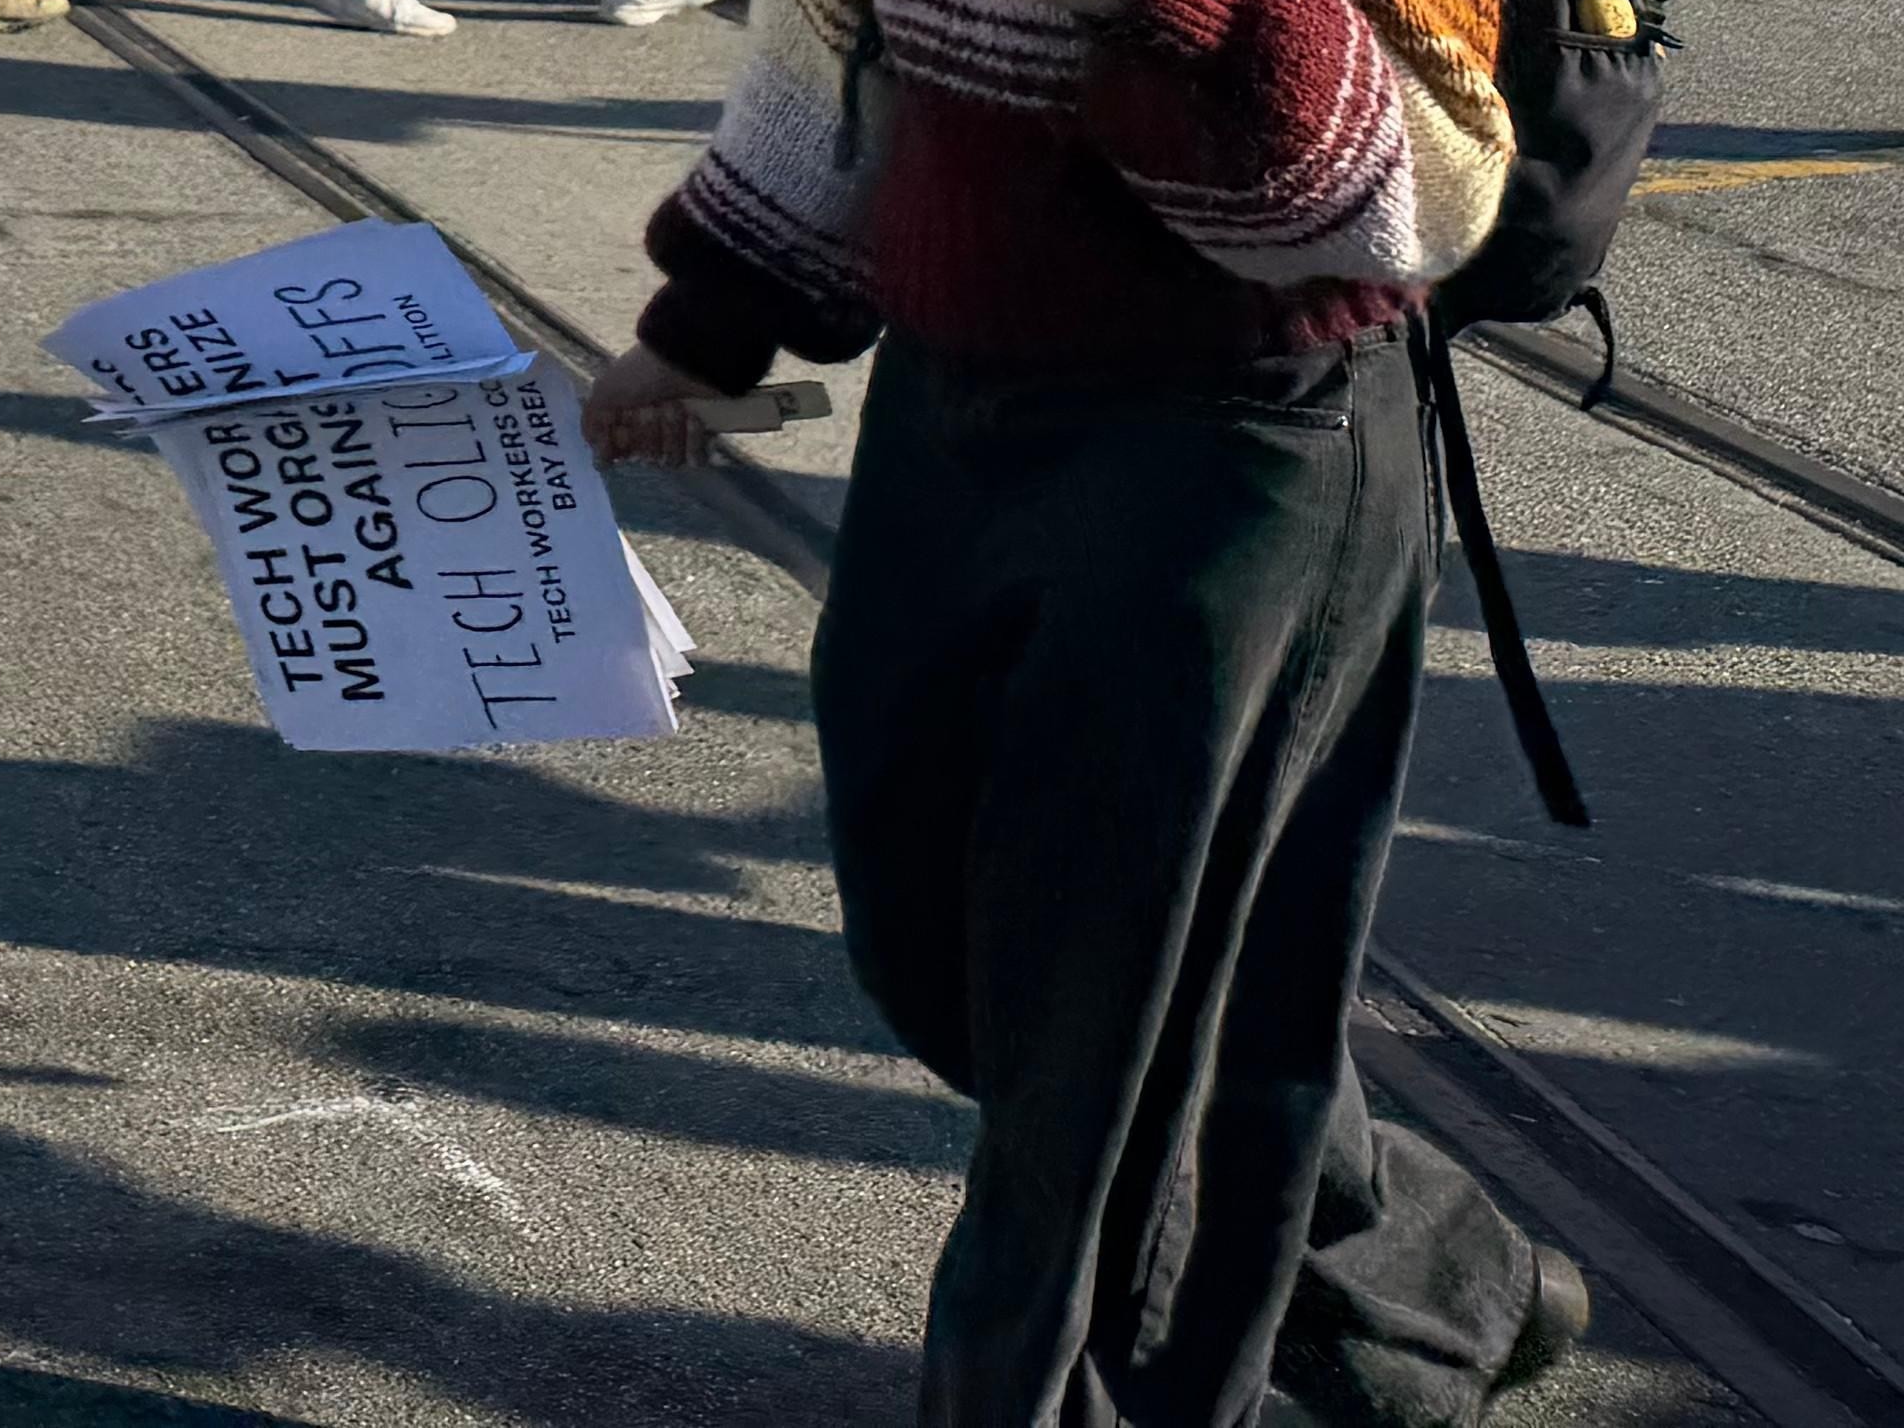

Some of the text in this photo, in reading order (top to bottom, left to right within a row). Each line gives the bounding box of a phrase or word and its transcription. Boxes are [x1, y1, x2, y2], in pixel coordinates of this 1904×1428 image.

[493, 413, 554, 559] WORKERS
[517, 380, 578, 511] BAY AREA
[246, 548, 323, 692] TECH
[302, 544, 385, 701] MUST
[437, 569, 557, 730] TECH
[535, 565, 576, 644] TECH
